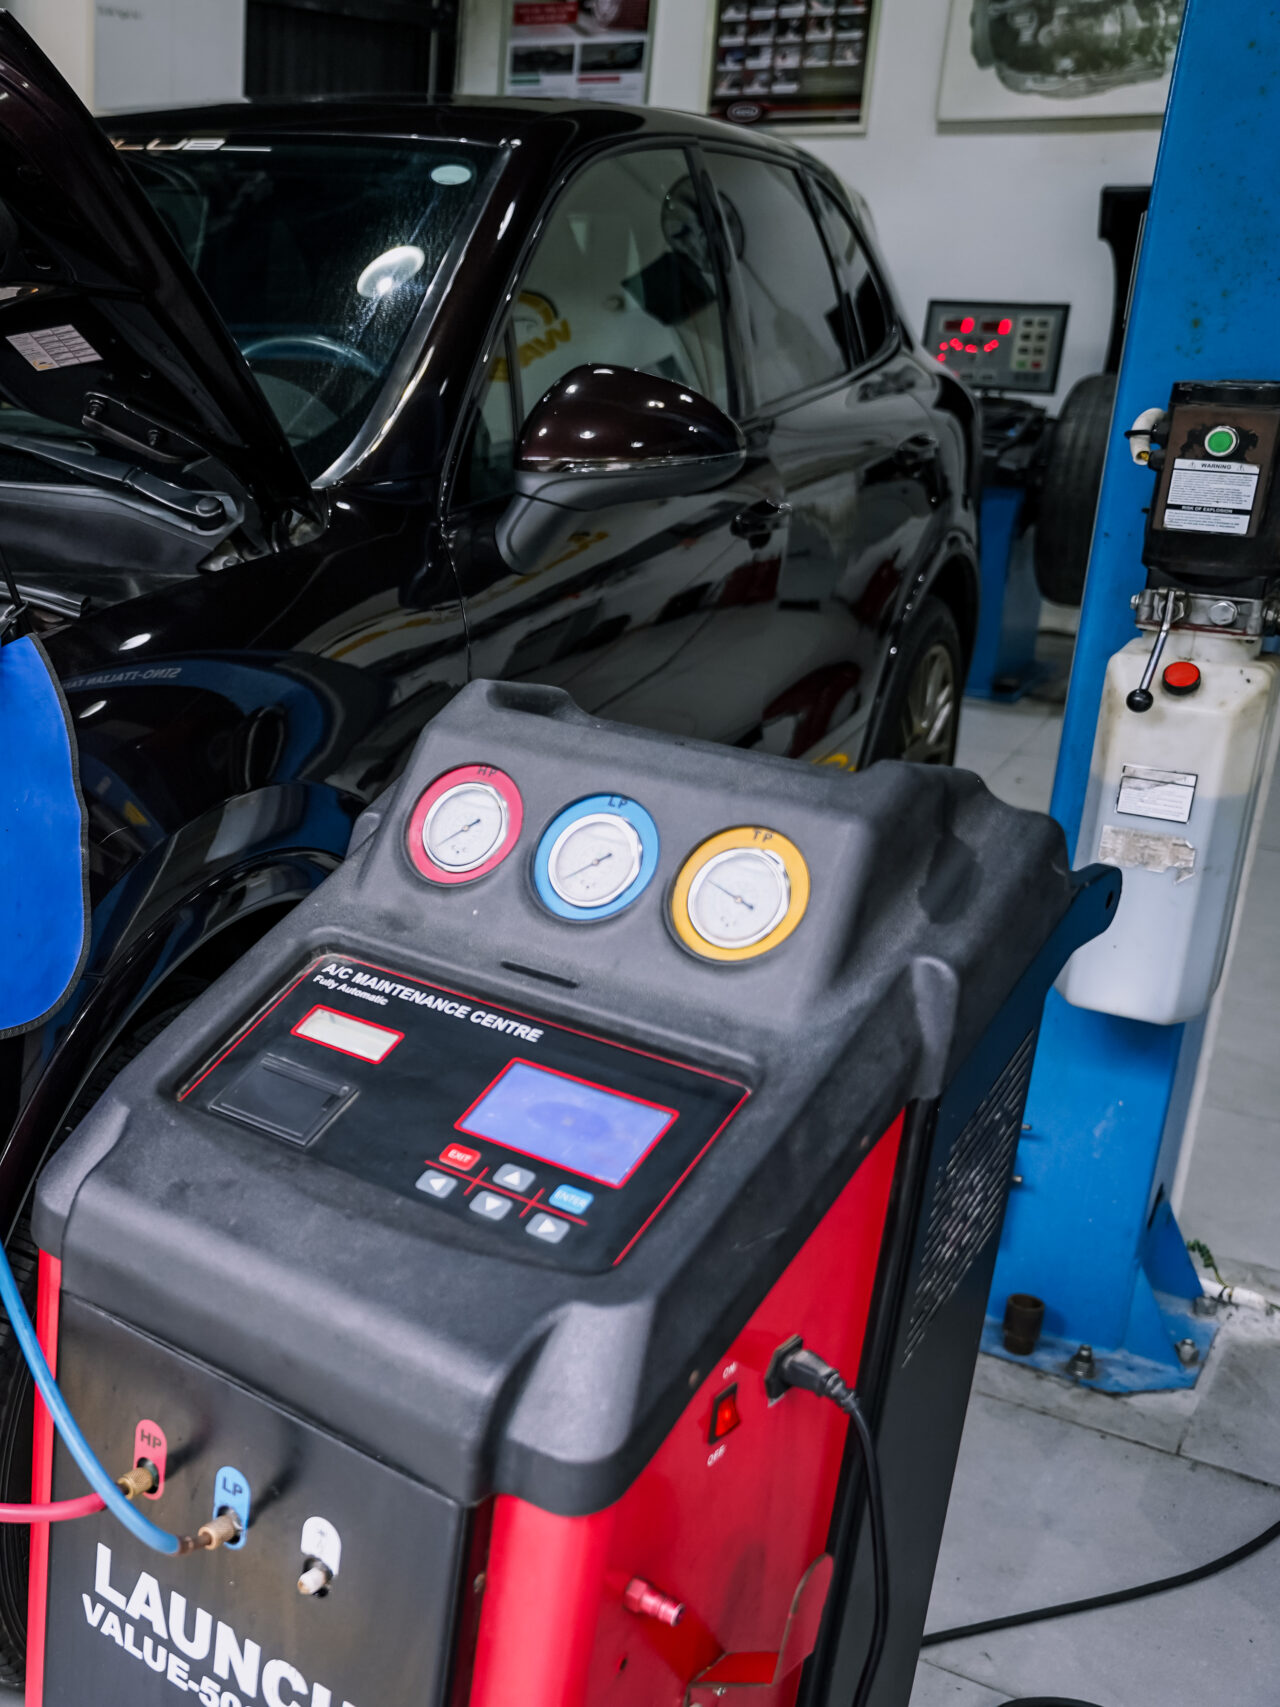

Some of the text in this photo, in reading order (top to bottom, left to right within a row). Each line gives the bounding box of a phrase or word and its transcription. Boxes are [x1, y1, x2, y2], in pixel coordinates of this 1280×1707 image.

[312, 974, 389, 1006] Fully Automatic
[321, 963, 545, 1043] A/C MAINTENANCE CENTRE
[448, 1148, 472, 1164] EXIT
[554, 1189, 588, 1208] ENTER
[722, 1360, 738, 1380] ON
[140, 1429, 162, 1449] HP
[707, 1444, 726, 1467] OFF
[222, 1476, 243, 1496] LP
[82, 1593, 251, 1707] VALUE-50
